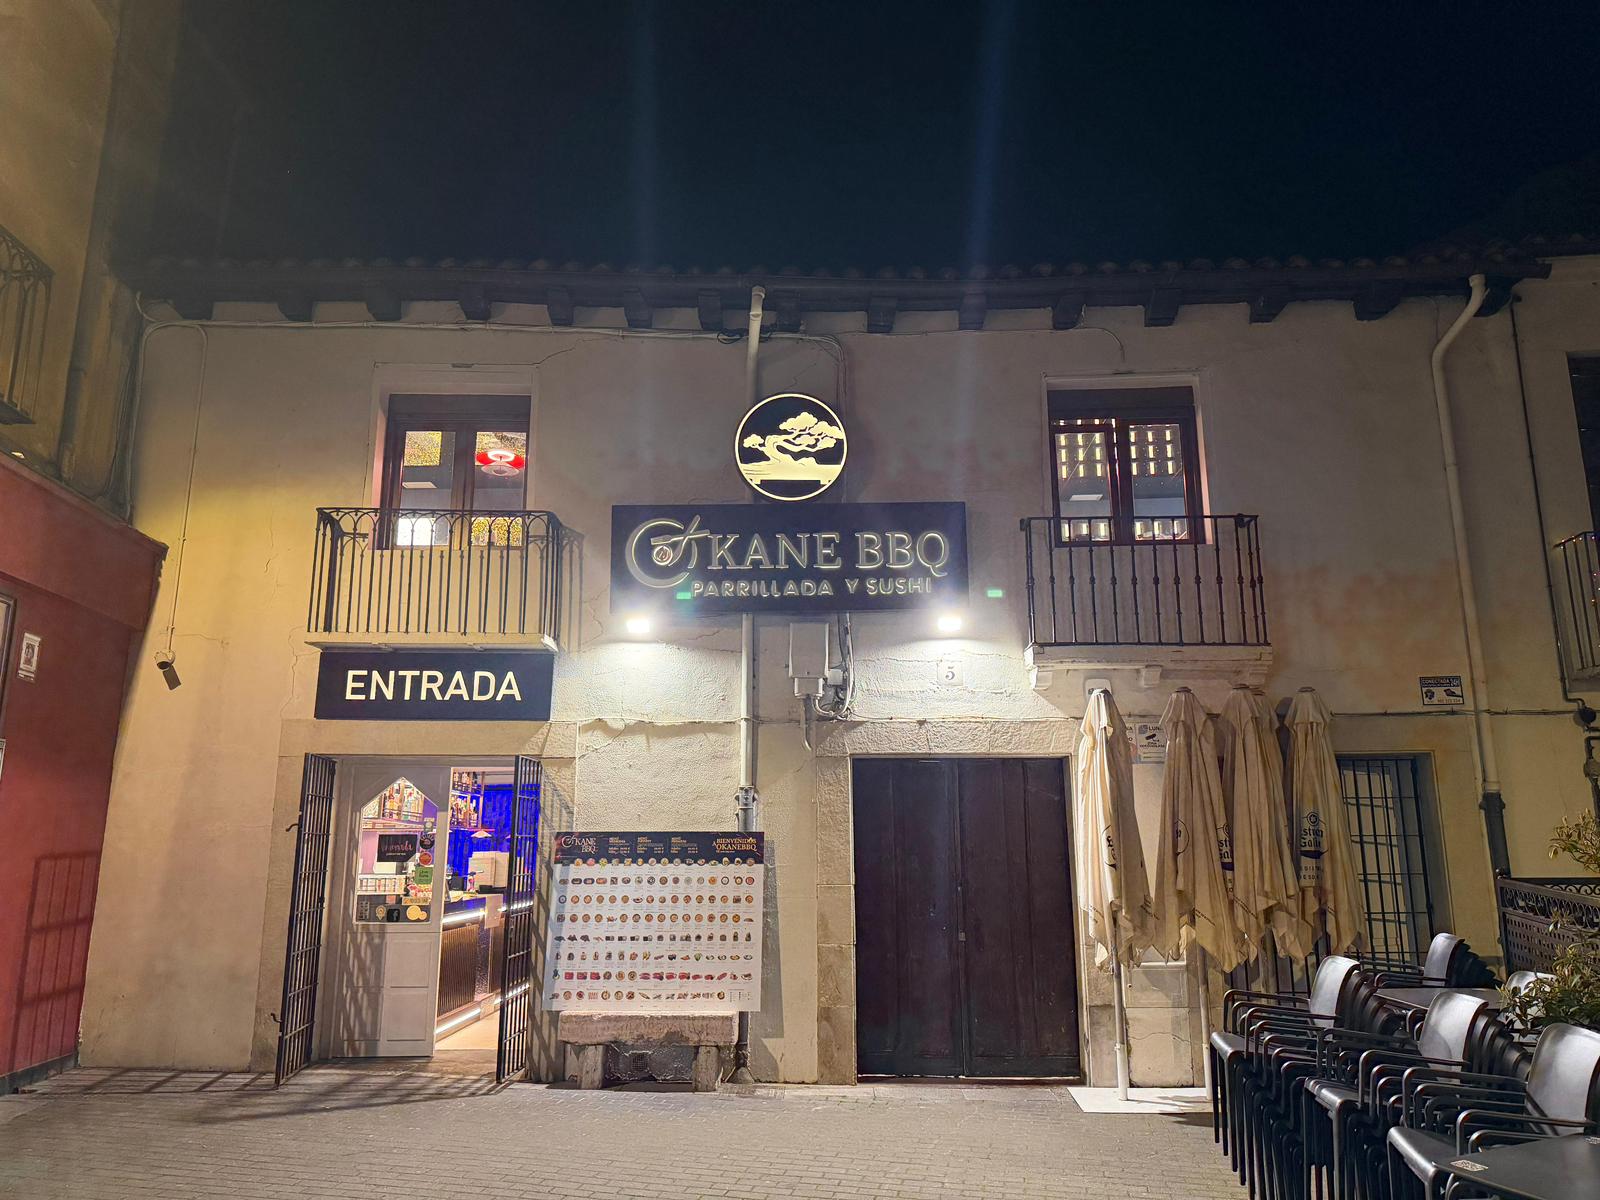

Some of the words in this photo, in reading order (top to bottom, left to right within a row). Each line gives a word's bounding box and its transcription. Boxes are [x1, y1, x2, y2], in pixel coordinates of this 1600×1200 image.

[855, 530, 949, 577] BBQ
[691, 579, 833, 597] PARRILLADA
[845, 578, 859, 594] Y
[866, 577, 932, 595] SUSHI
[345, 669, 522, 701] ENTRADA
[945, 666, 956, 681] 5
